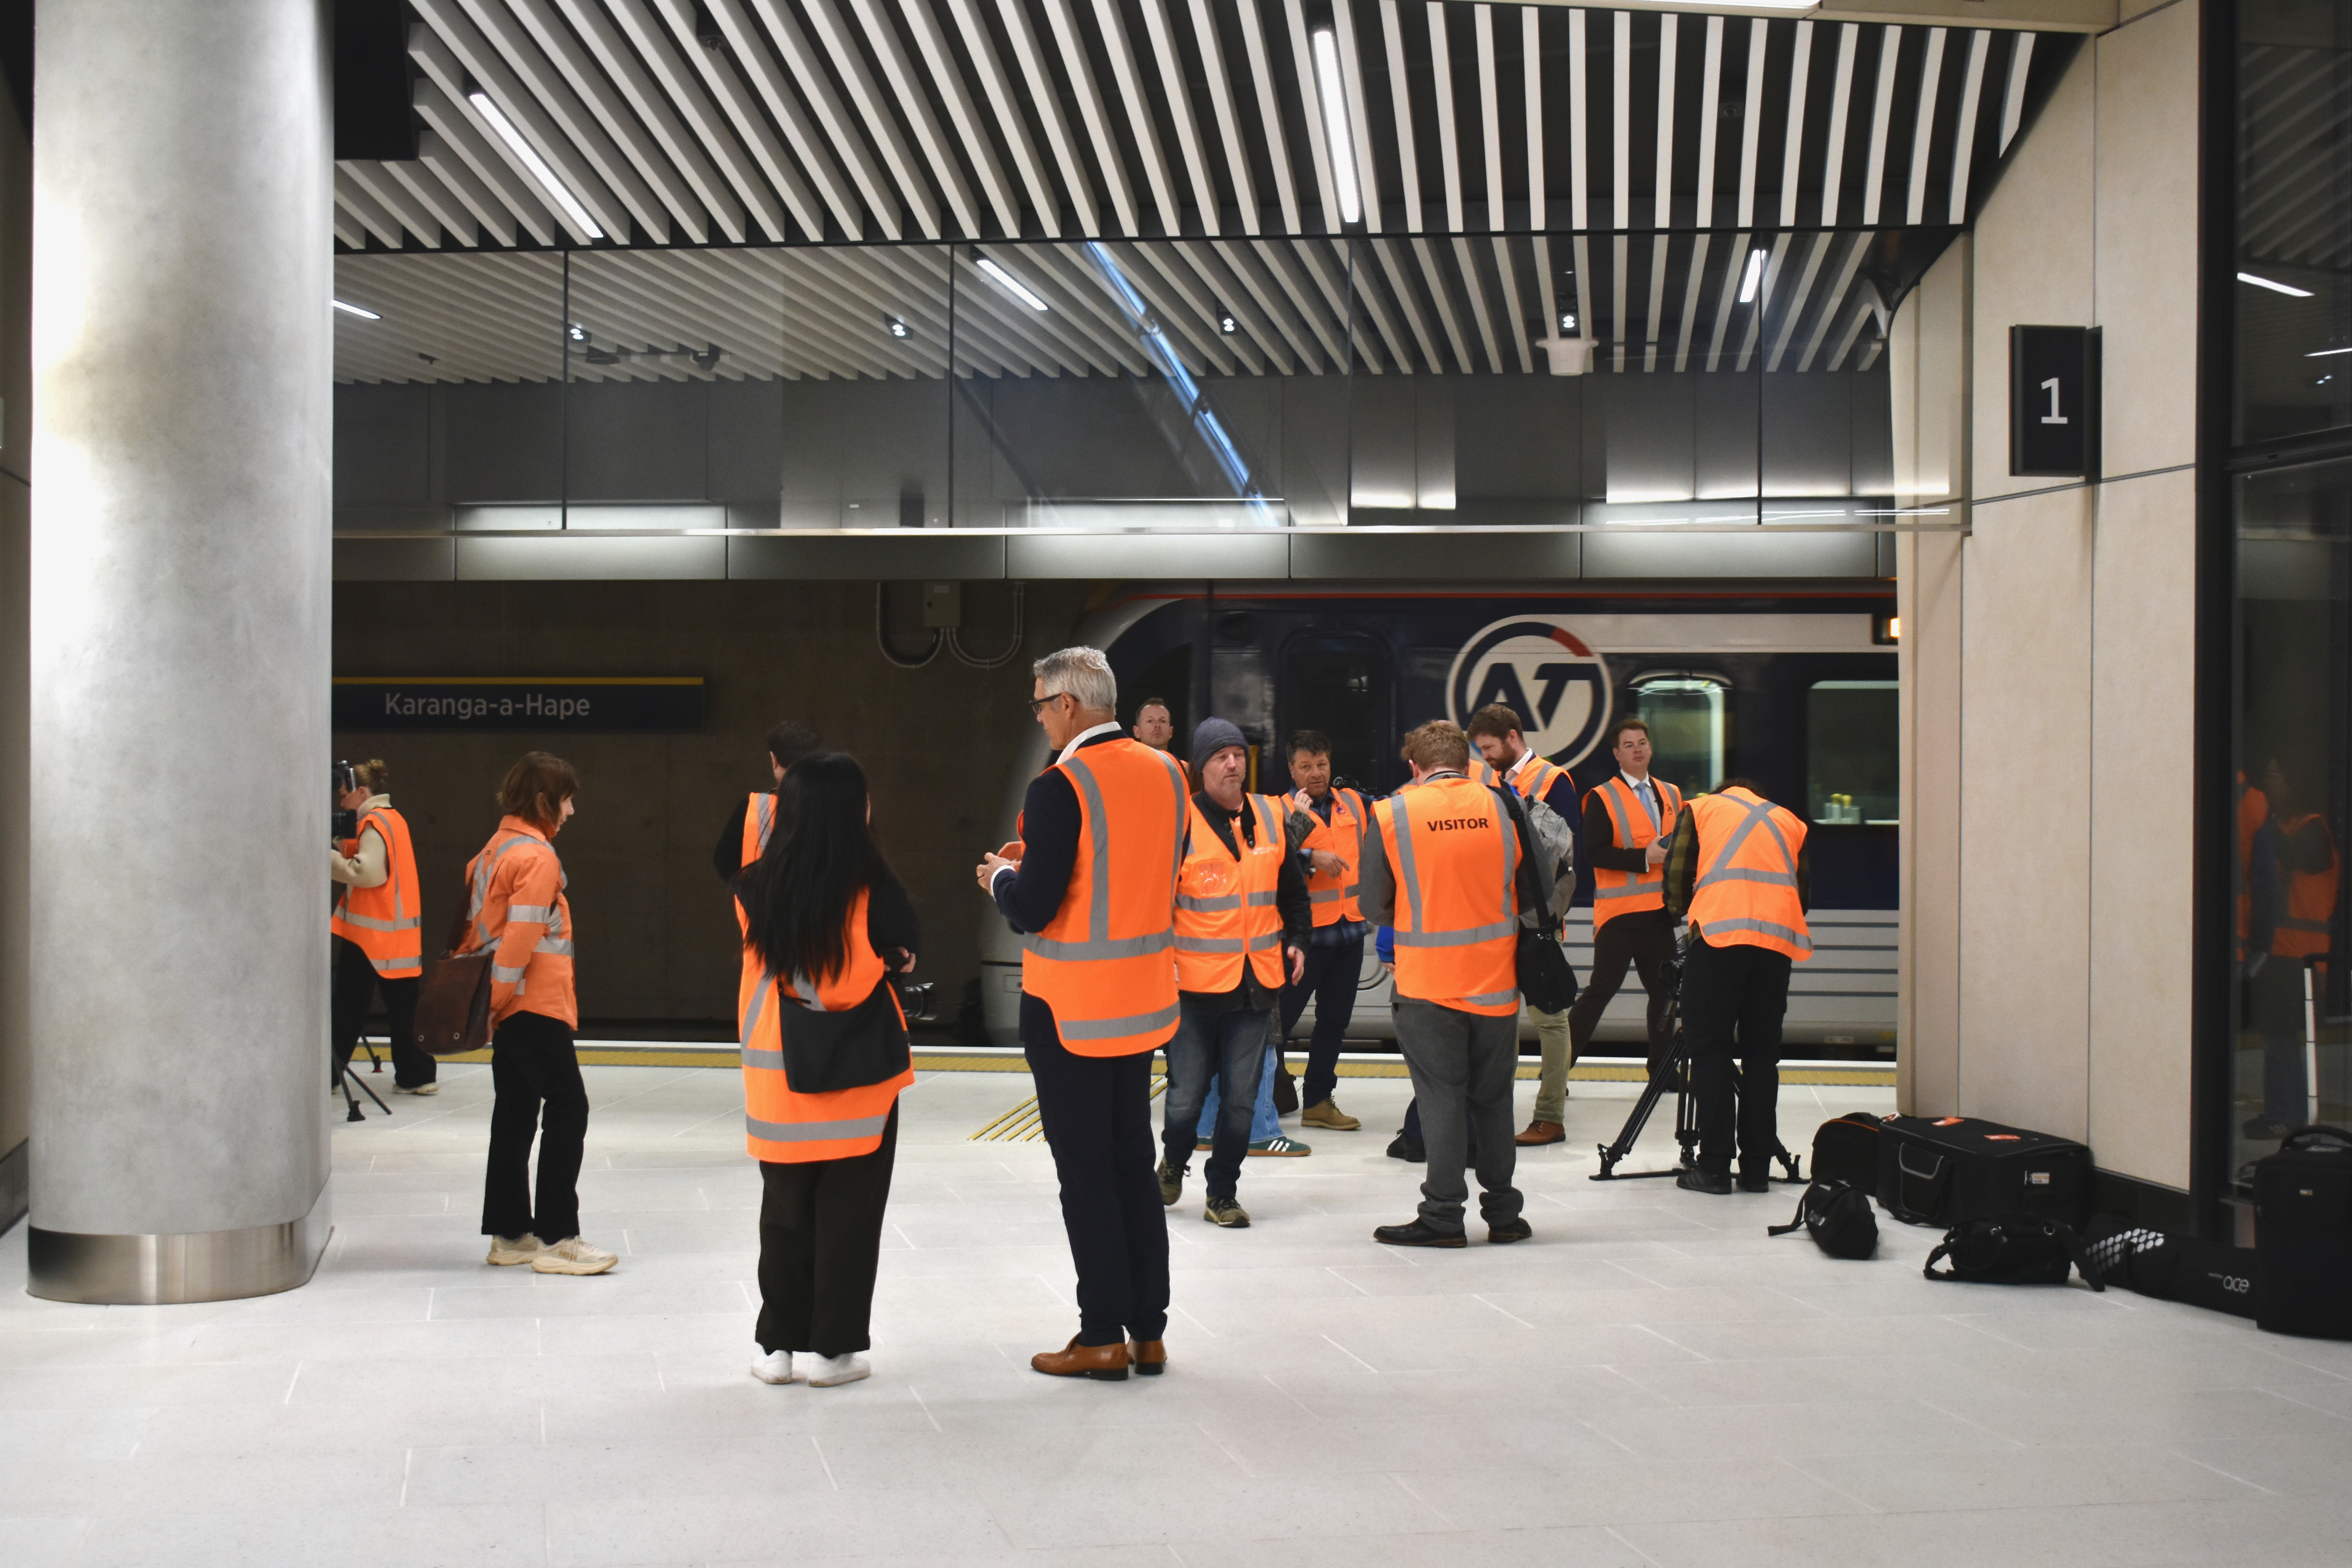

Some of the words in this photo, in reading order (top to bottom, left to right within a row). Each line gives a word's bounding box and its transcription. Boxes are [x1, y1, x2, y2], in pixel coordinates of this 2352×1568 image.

[2041, 378, 2068, 423] 1
[385, 693, 590, 720] Karanga-a-Hape
[1465, 662, 1600, 732] AT
[1427, 818, 1488, 831] VISITOR
[2223, 1275, 2249, 1293] ace
